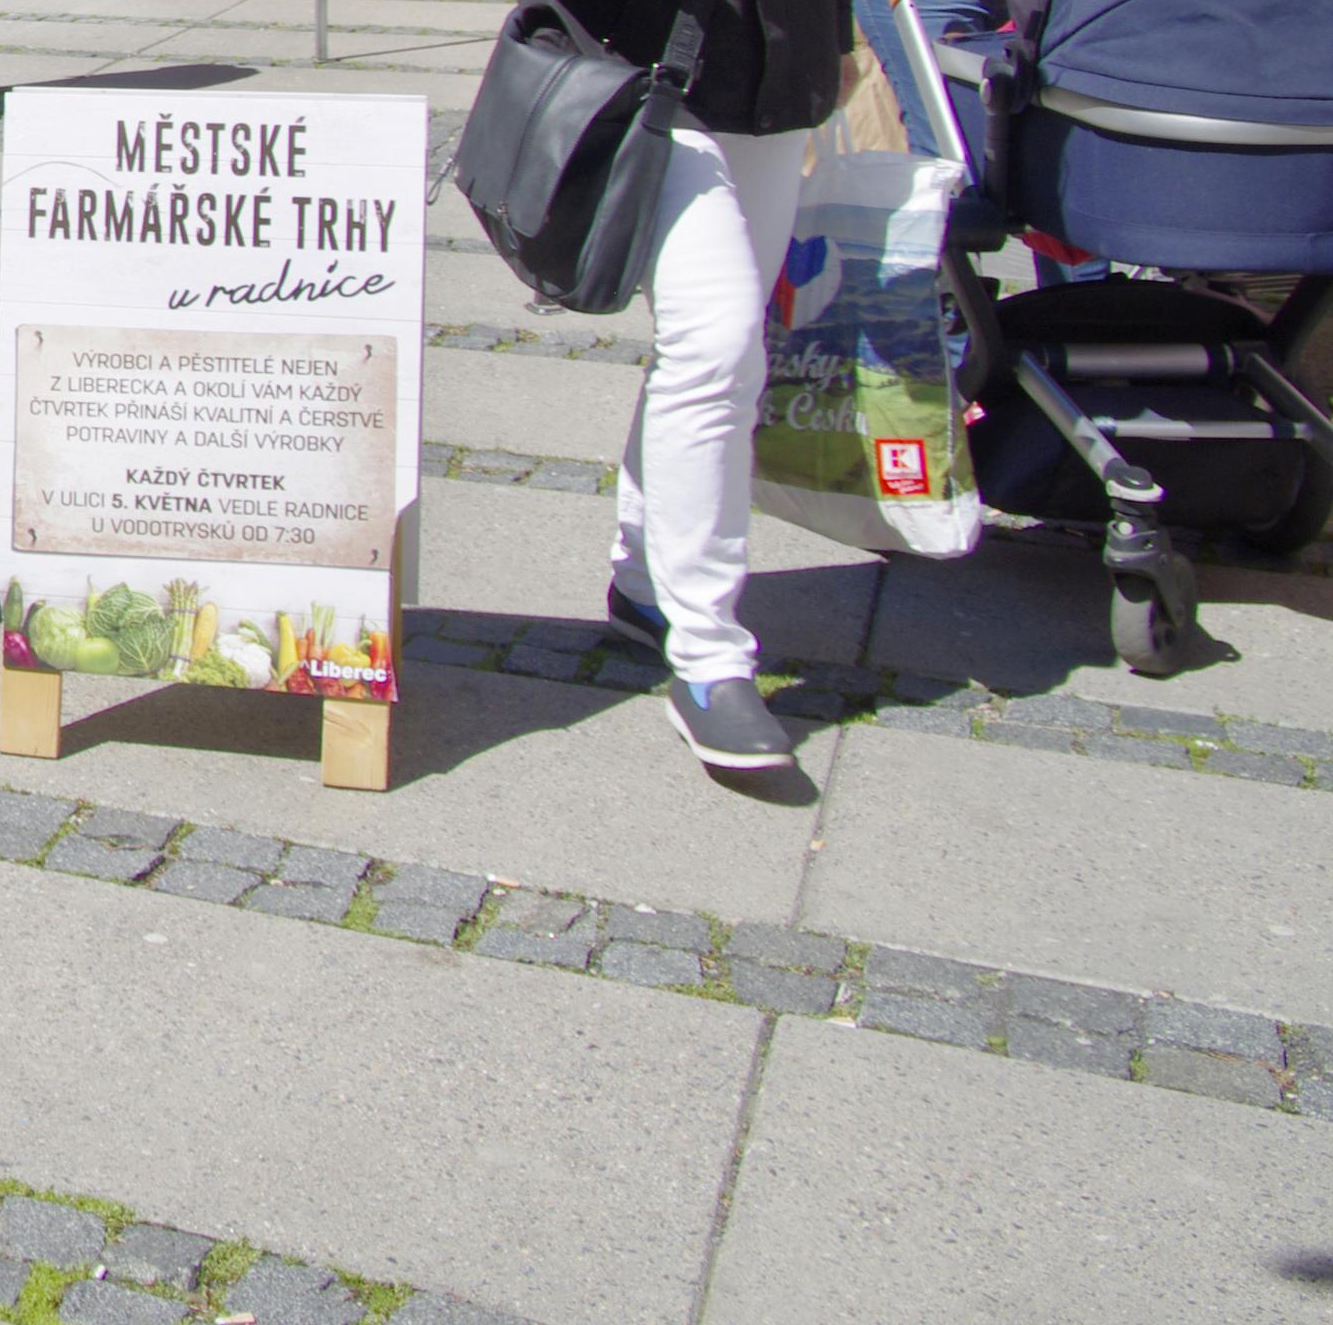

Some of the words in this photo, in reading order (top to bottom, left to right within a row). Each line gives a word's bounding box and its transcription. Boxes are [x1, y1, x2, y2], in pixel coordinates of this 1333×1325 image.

[116, 113, 307, 177] MĚSTSKÉ
[28, 183, 272, 248] FARMÁŘSKÉ
[292, 195, 396, 253] TRHY
[168, 290, 200, 310] u
[205, 258, 396, 308] radnice
[72, 349, 153, 371] VÝROBCI
[159, 355, 172, 371] A
[179, 351, 274, 375] PĚSTITELÉ
[281, 358, 339, 376] NEJEN
[50, 376, 61, 391] Z
[68, 378, 168, 396] LIBERECKA
[173, 381, 187, 396] A
[193, 378, 246, 398] OKOLÍ
[251, 380, 293, 400] VÁM
[299, 382, 363, 403] KAŽDÝ
[29, 397, 109, 417] ČTVRTEK
[115, 399, 188, 422] PŘINÁŠÍ
[193, 403, 274, 425] KVALITNÍ
[278, 409, 293, 425] A
[298, 405, 385, 429] ČERSTVÉ
[66, 425, 169, 446] POTRAVINY
[174, 431, 188, 446] A
[194, 429, 248, 449] DALŠÍ
[254, 430, 345, 453] VÝROBKY
[126, 465, 191, 487] KAŽDÝ
[197, 467, 286, 491] ČTVRTEK
[41, 490, 55, 505] V
[60, 490, 106, 508] ULICI
[111, 494, 128, 510] 5.
[134, 492, 213, 514] KVĚTNA
[218, 498, 279, 517] VEDLE
[284, 503, 369, 522] RADNICE
[91, 517, 104, 533] U
[111, 518, 235, 540] VODOTRYSKŮ
[242, 526, 269, 542] OD
[275, 527, 315, 544] 7:30
[310, 660, 388, 682] Liberec
